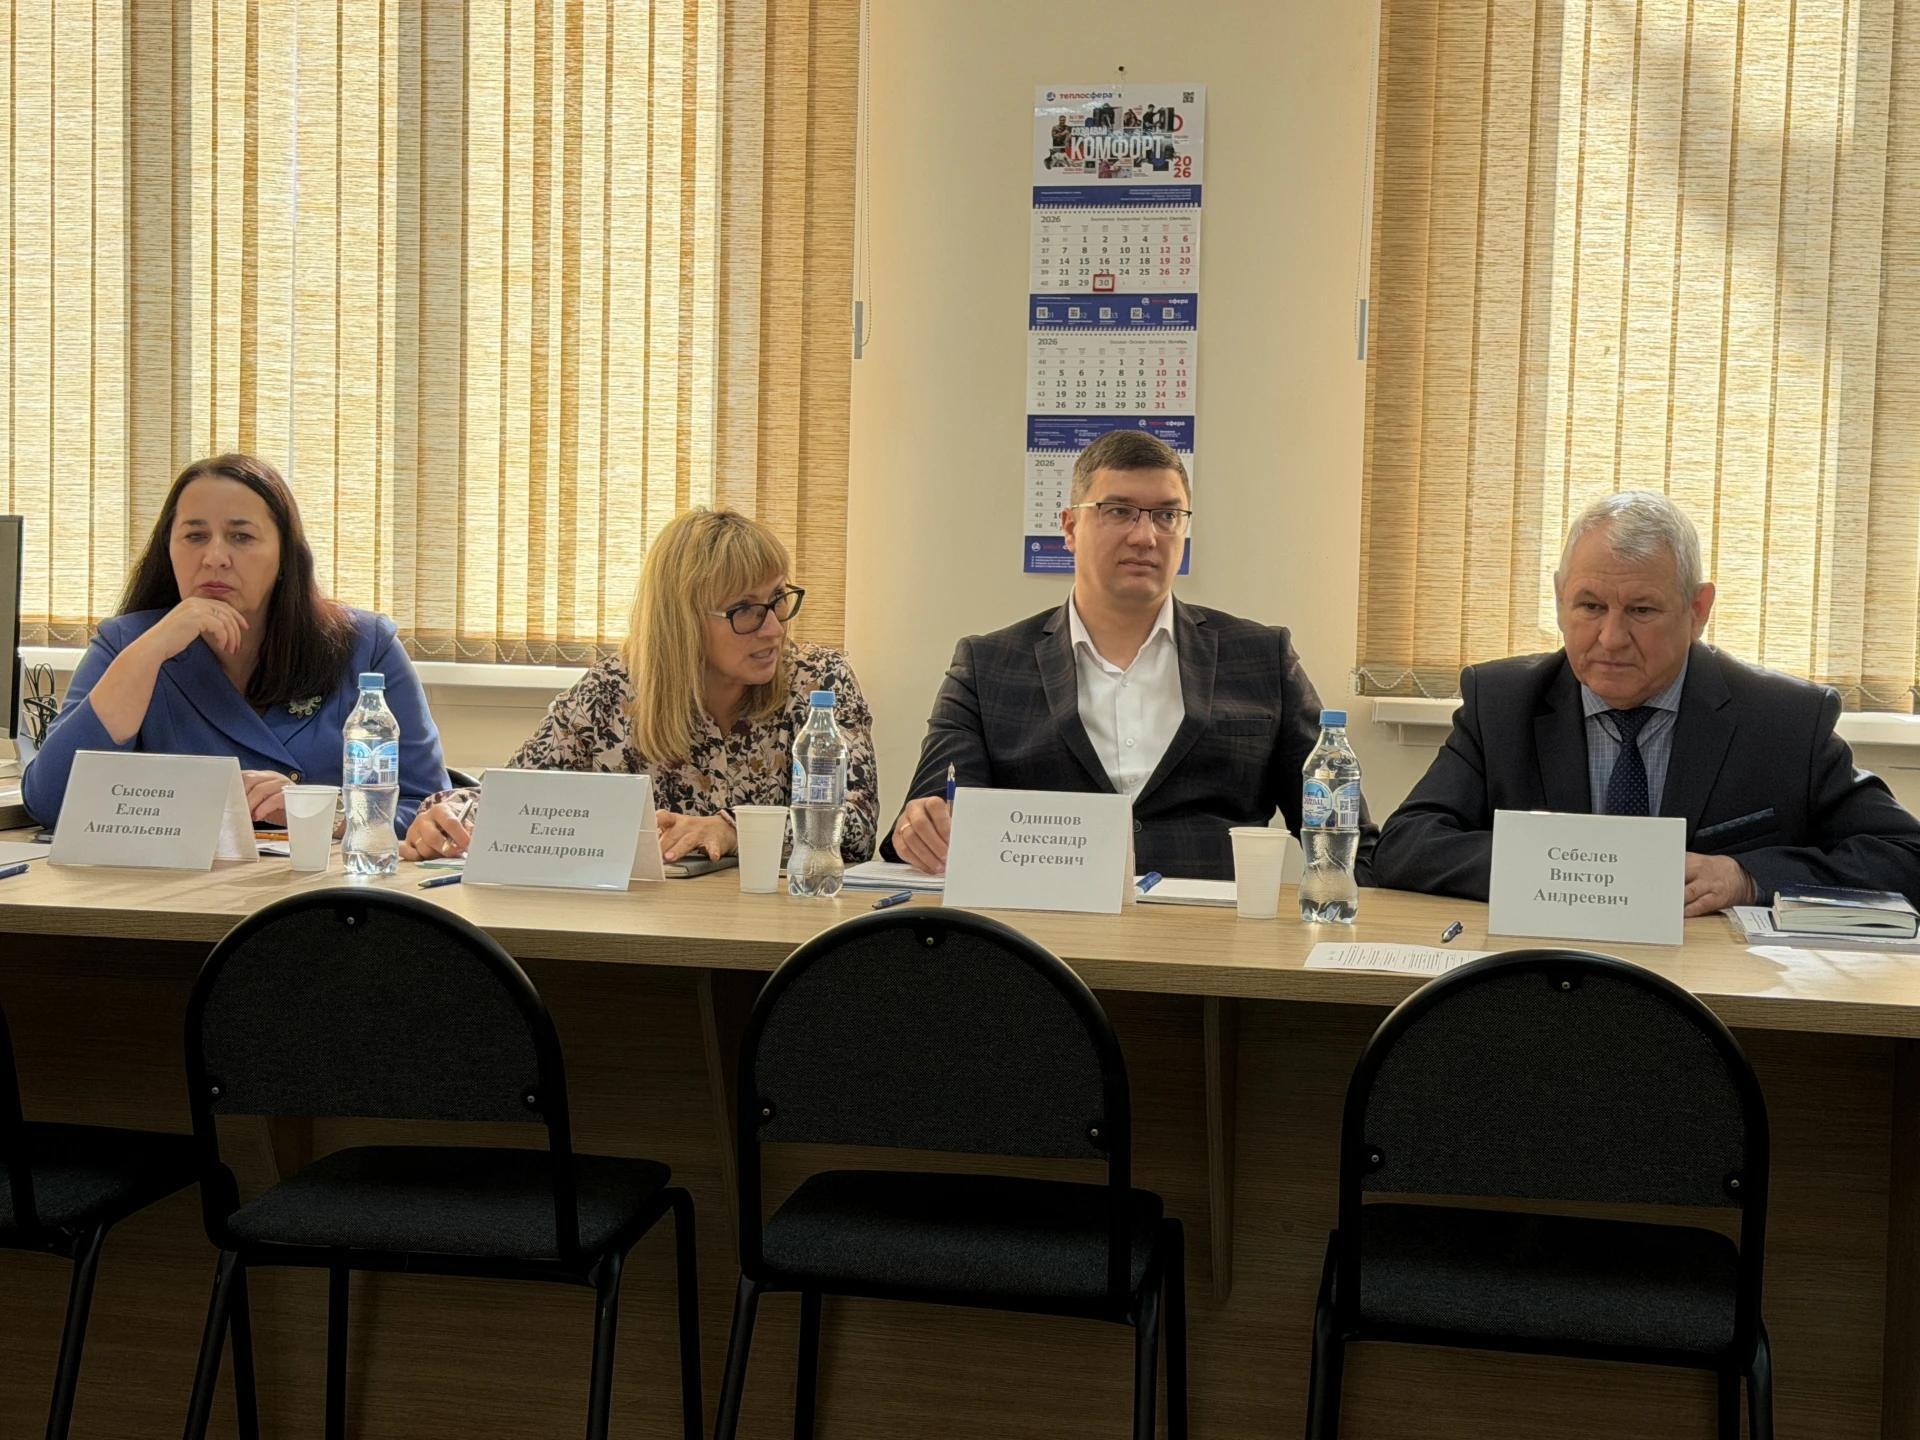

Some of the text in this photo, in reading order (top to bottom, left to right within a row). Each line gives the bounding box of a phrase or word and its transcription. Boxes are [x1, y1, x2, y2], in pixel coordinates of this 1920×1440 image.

[1071, 136, 1164, 160] КОМФОРТ
[1174, 156, 1192, 167] 20
[1174, 168, 1191, 178] 26
[112, 784, 174, 798] Сысоева
[116, 803, 160, 816] Елена
[519, 804, 589, 819] Андреева
[1010, 811, 1080, 825] Одинцов
[85, 821, 181, 836] Анатольевна
[531, 823, 574, 836] Елена
[1001, 831, 1086, 848] Александр
[488, 841, 603, 858] Александровна
[1548, 848, 1617, 862] Себелев
[1000, 850, 1083, 866] Сергеевич
[1551, 868, 1614, 887] Виктор
[1534, 889, 1627, 906] Андреевич
